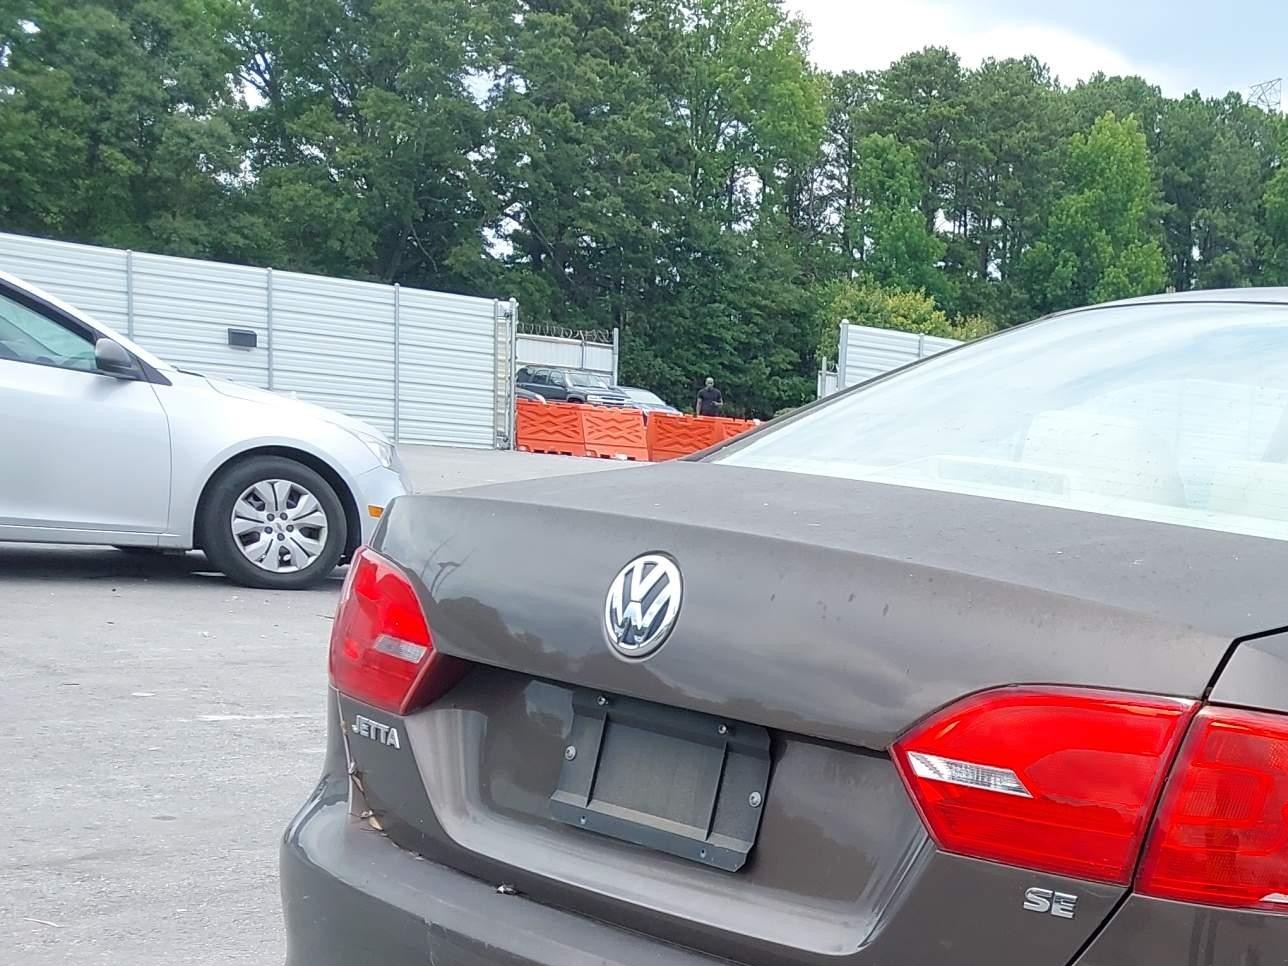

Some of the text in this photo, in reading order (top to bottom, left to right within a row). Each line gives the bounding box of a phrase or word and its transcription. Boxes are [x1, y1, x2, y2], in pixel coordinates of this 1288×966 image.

[606, 554, 681, 652] VW
[351, 714, 400, 749] JETTA
[1023, 887, 1078, 919] SE
